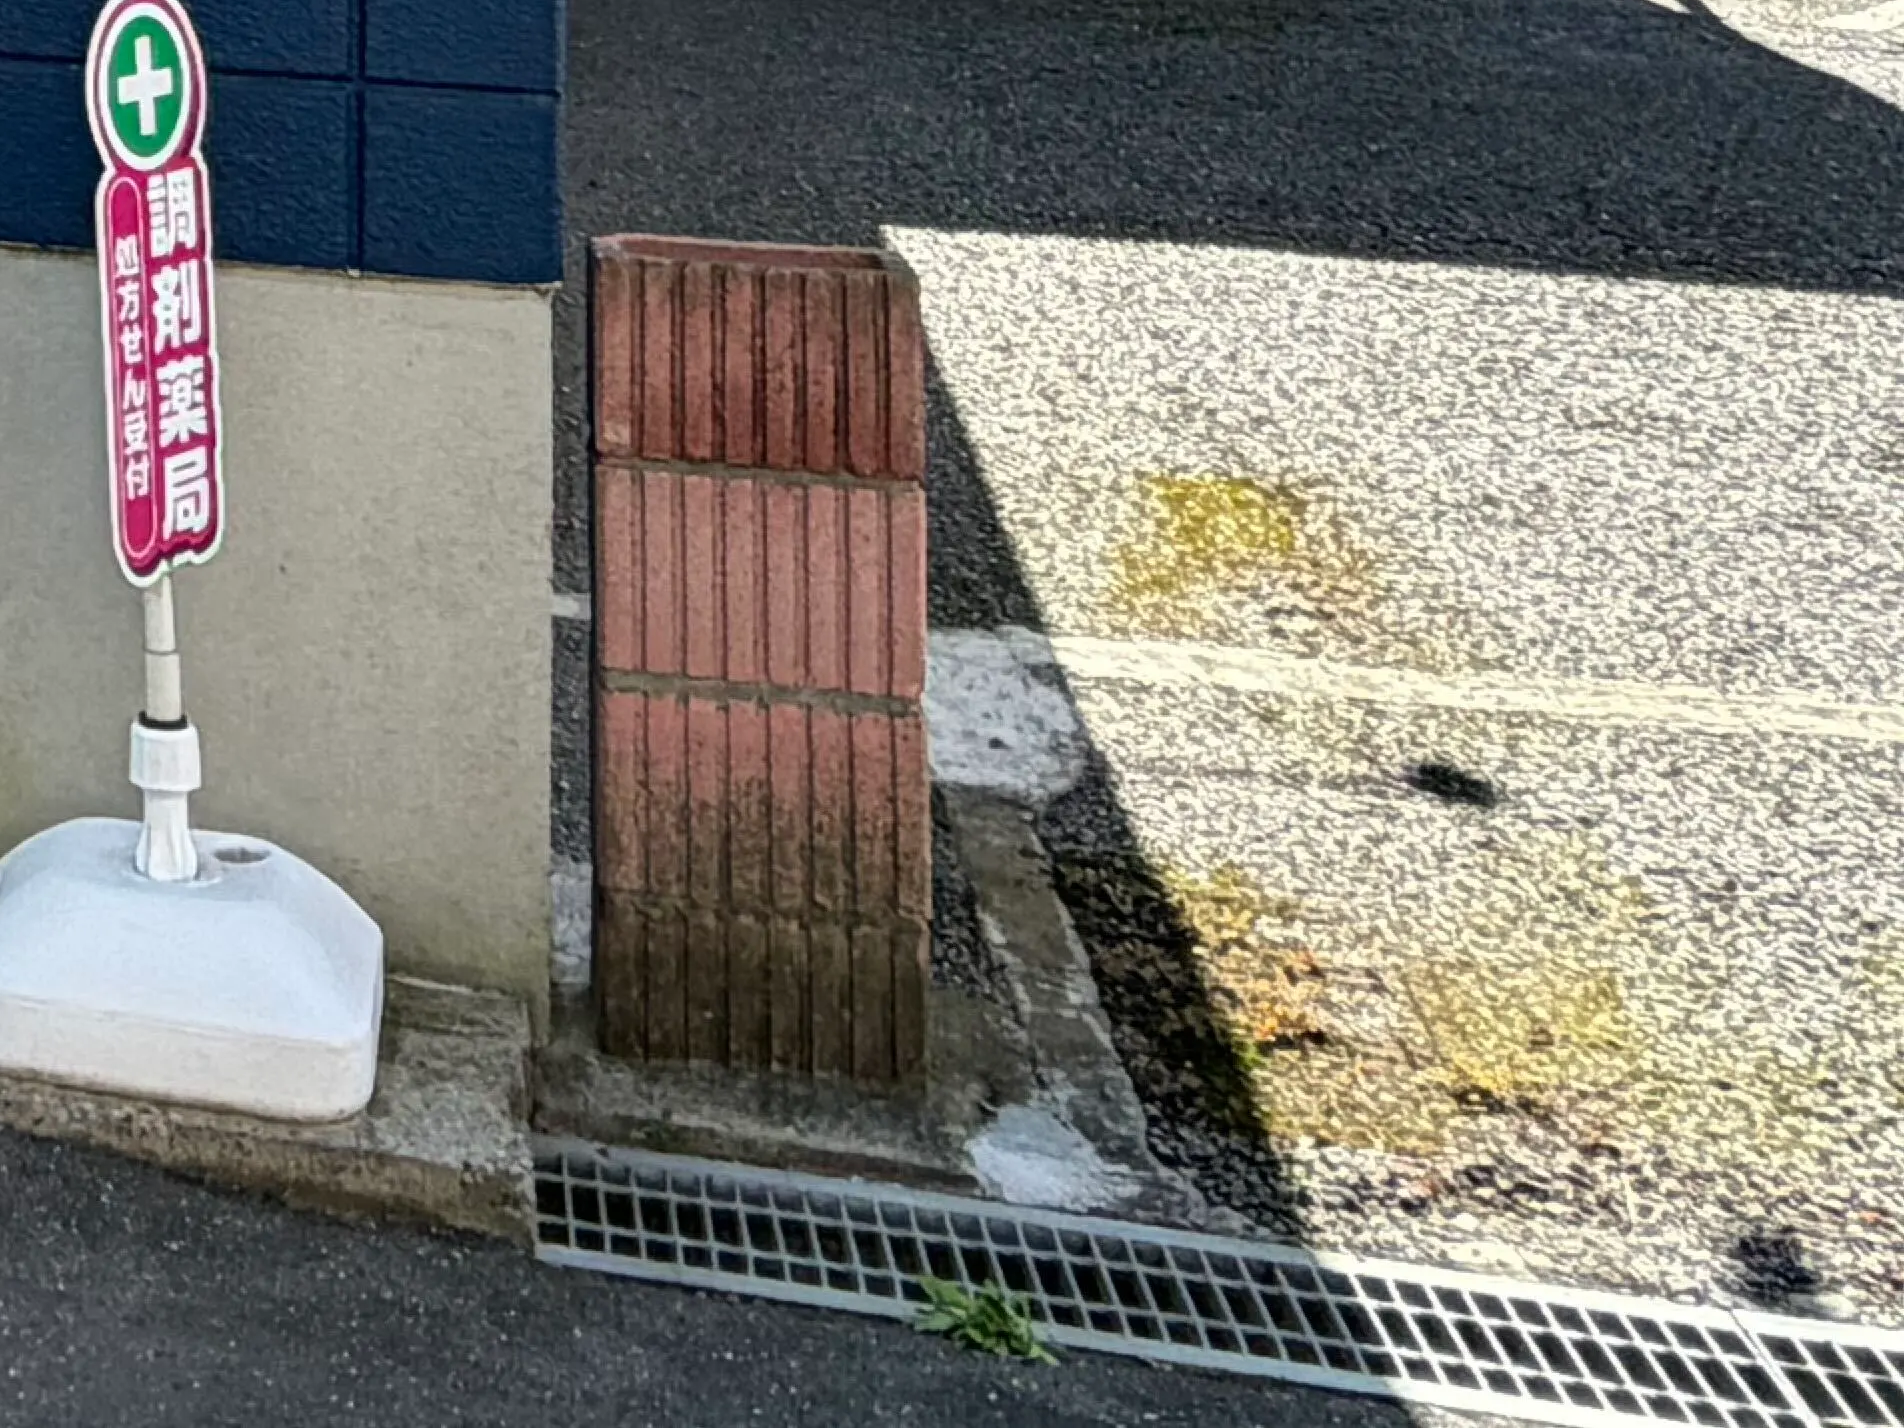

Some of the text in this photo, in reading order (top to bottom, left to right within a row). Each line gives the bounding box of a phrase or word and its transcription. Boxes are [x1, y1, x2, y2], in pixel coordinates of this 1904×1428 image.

[114, 235, 151, 500] 処方せん受付
[147, 167, 208, 542] 調剤薬局
